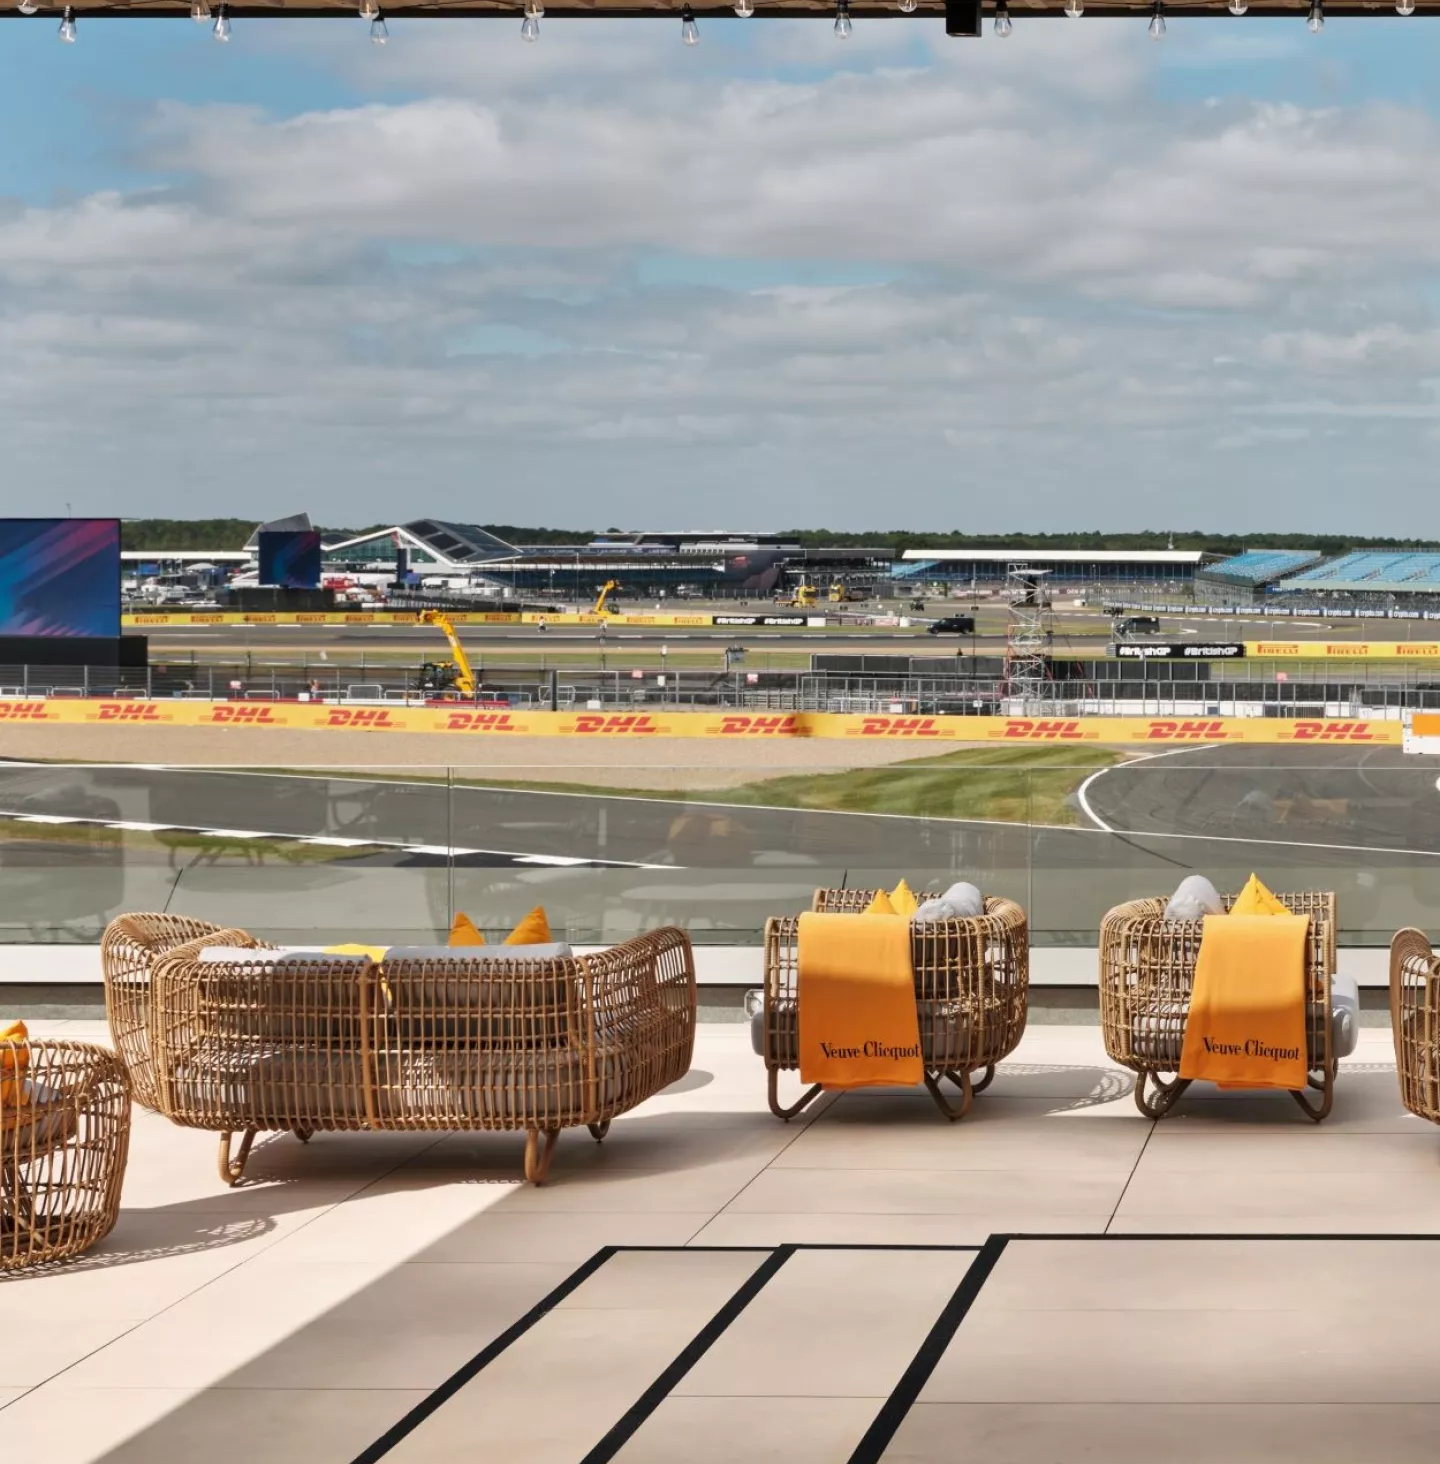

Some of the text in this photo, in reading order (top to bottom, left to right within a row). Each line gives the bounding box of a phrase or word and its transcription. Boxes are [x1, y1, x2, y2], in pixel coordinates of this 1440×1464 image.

[1184, 647, 1238, 656] #BritishGP
[1257, 644, 1298, 654] PIRELLI
[1327, 644, 1368, 654] PIRELLI
[1396, 644, 1438, 655] PIRELLI
[98, 704, 160, 720] DHL
[211, 706, 275, 723] DHL
[327, 710, 394, 727] DHL
[447, 713, 517, 731] DHL
[574, 716, 657, 733] DHL
[720, 717, 799, 734] DHL
[861, 718, 941, 736] DHL
[1004, 720, 1085, 738] DHL
[1147, 722, 1229, 738] DHL
[1292, 723, 1376, 740] DHL
[820, 1041, 920, 1060] Veuve Clicquot
[1203, 1037, 1300, 1062] Veuve Clicquot
